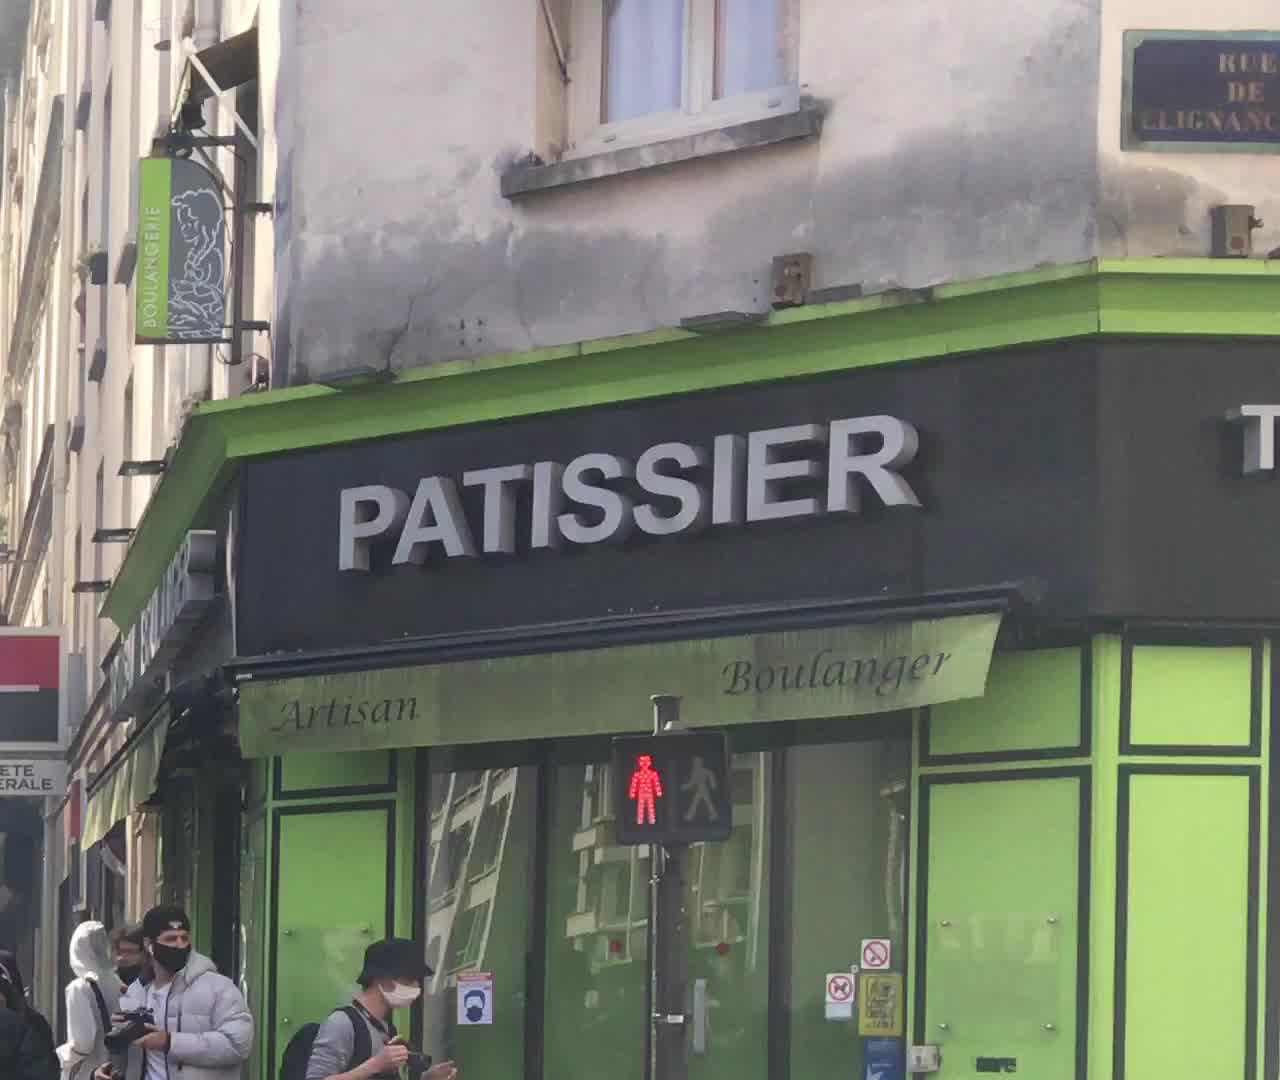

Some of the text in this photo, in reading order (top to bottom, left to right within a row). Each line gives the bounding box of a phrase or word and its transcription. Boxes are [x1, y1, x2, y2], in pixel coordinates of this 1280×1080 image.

[1218, 52, 1278, 73] RUE
[1227, 80, 1264, 103] DE
[143, 206, 161, 329] BOULANGERIE
[338, 414, 924, 571] PATISSIER
[722, 648, 952, 697] Boulanger
[270, 695, 420, 732] Artisan
